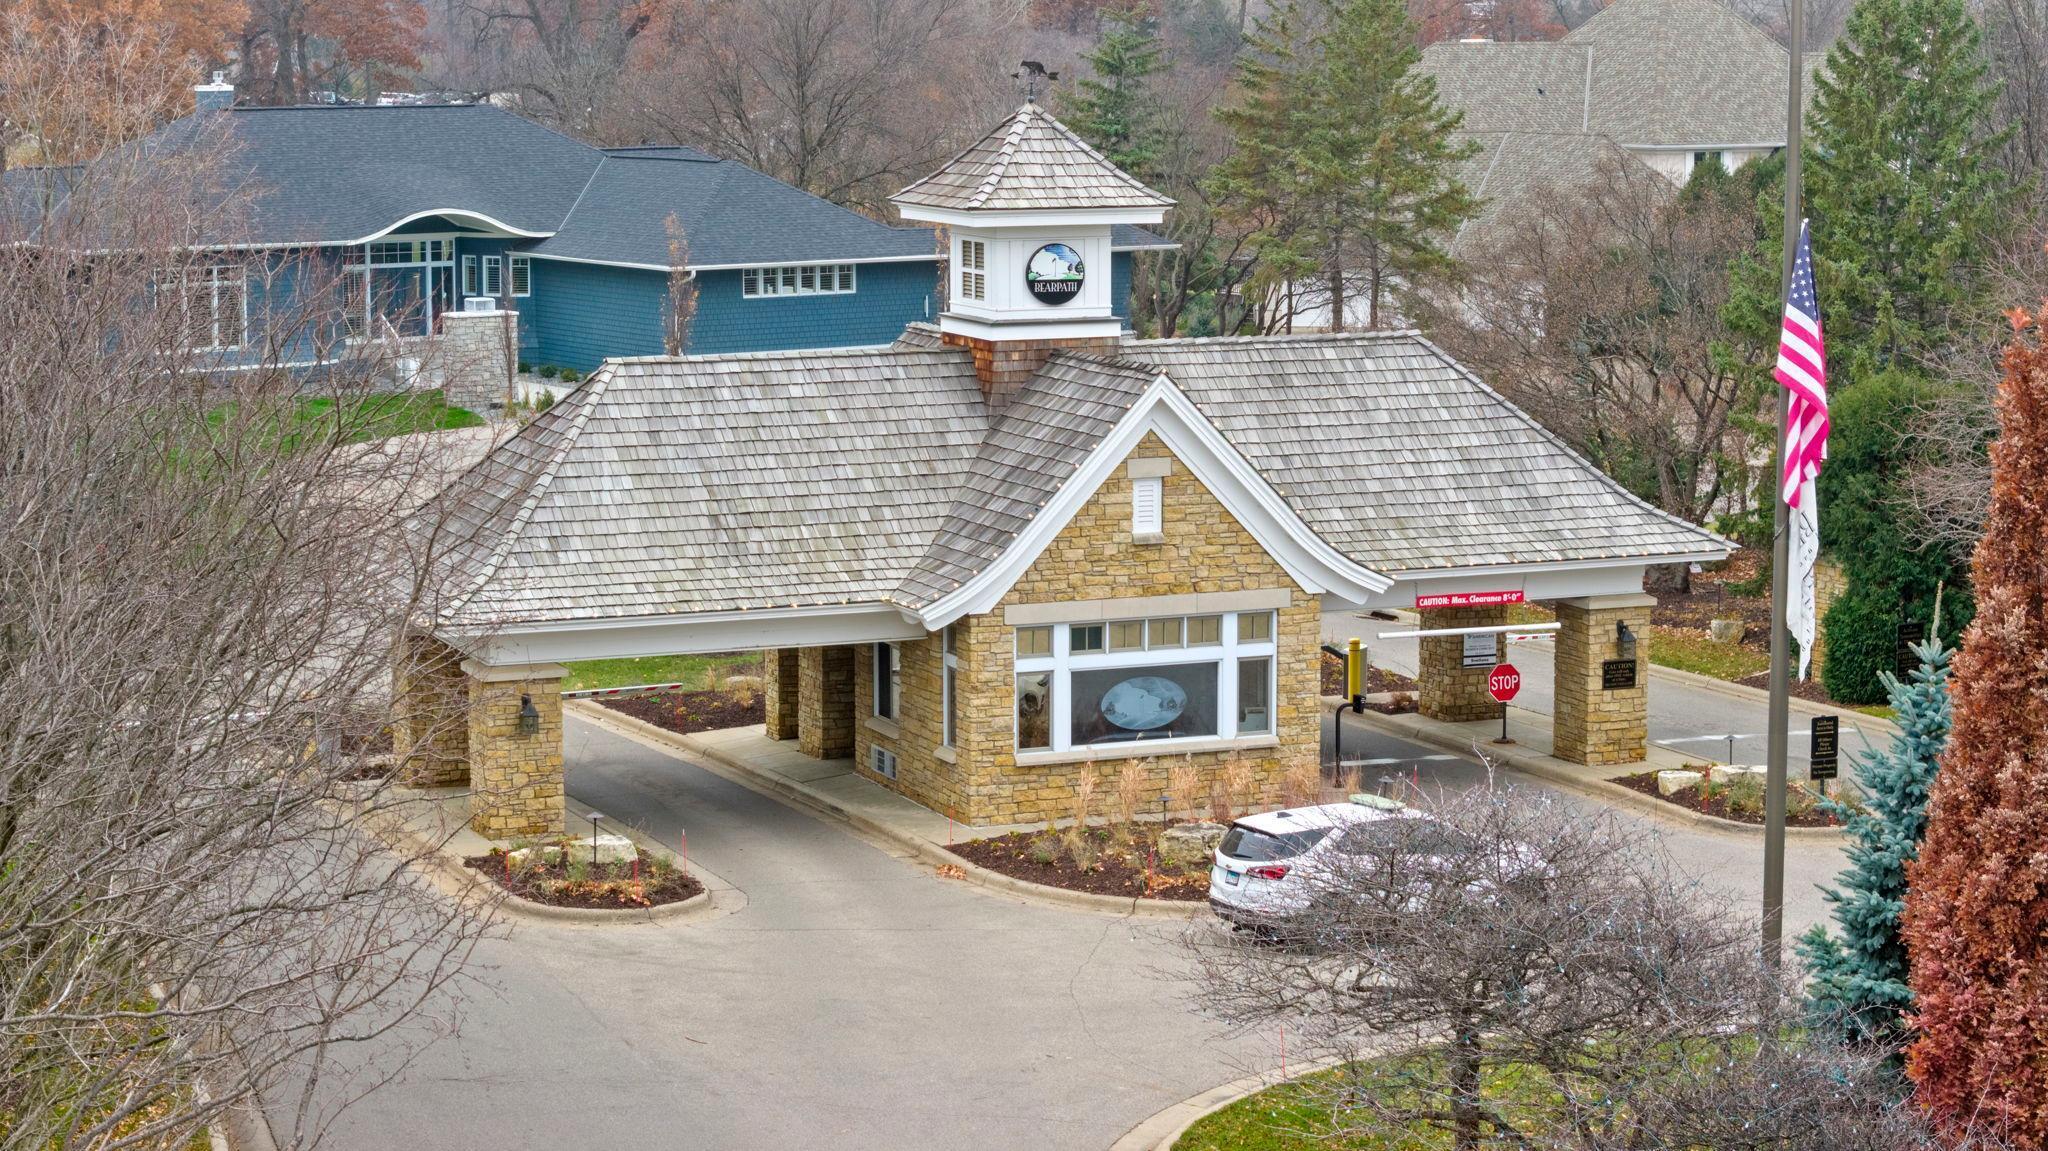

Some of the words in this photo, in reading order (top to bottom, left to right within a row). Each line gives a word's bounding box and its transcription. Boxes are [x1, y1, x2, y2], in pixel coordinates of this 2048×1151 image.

[1034, 282, 1077, 293] BEARPATH
[1419, 597, 1450, 606] CAUTION:
[1451, 596, 1468, 604] Max.
[1469, 594, 1502, 603] Clearance
[1491, 675, 1519, 691] STOP
